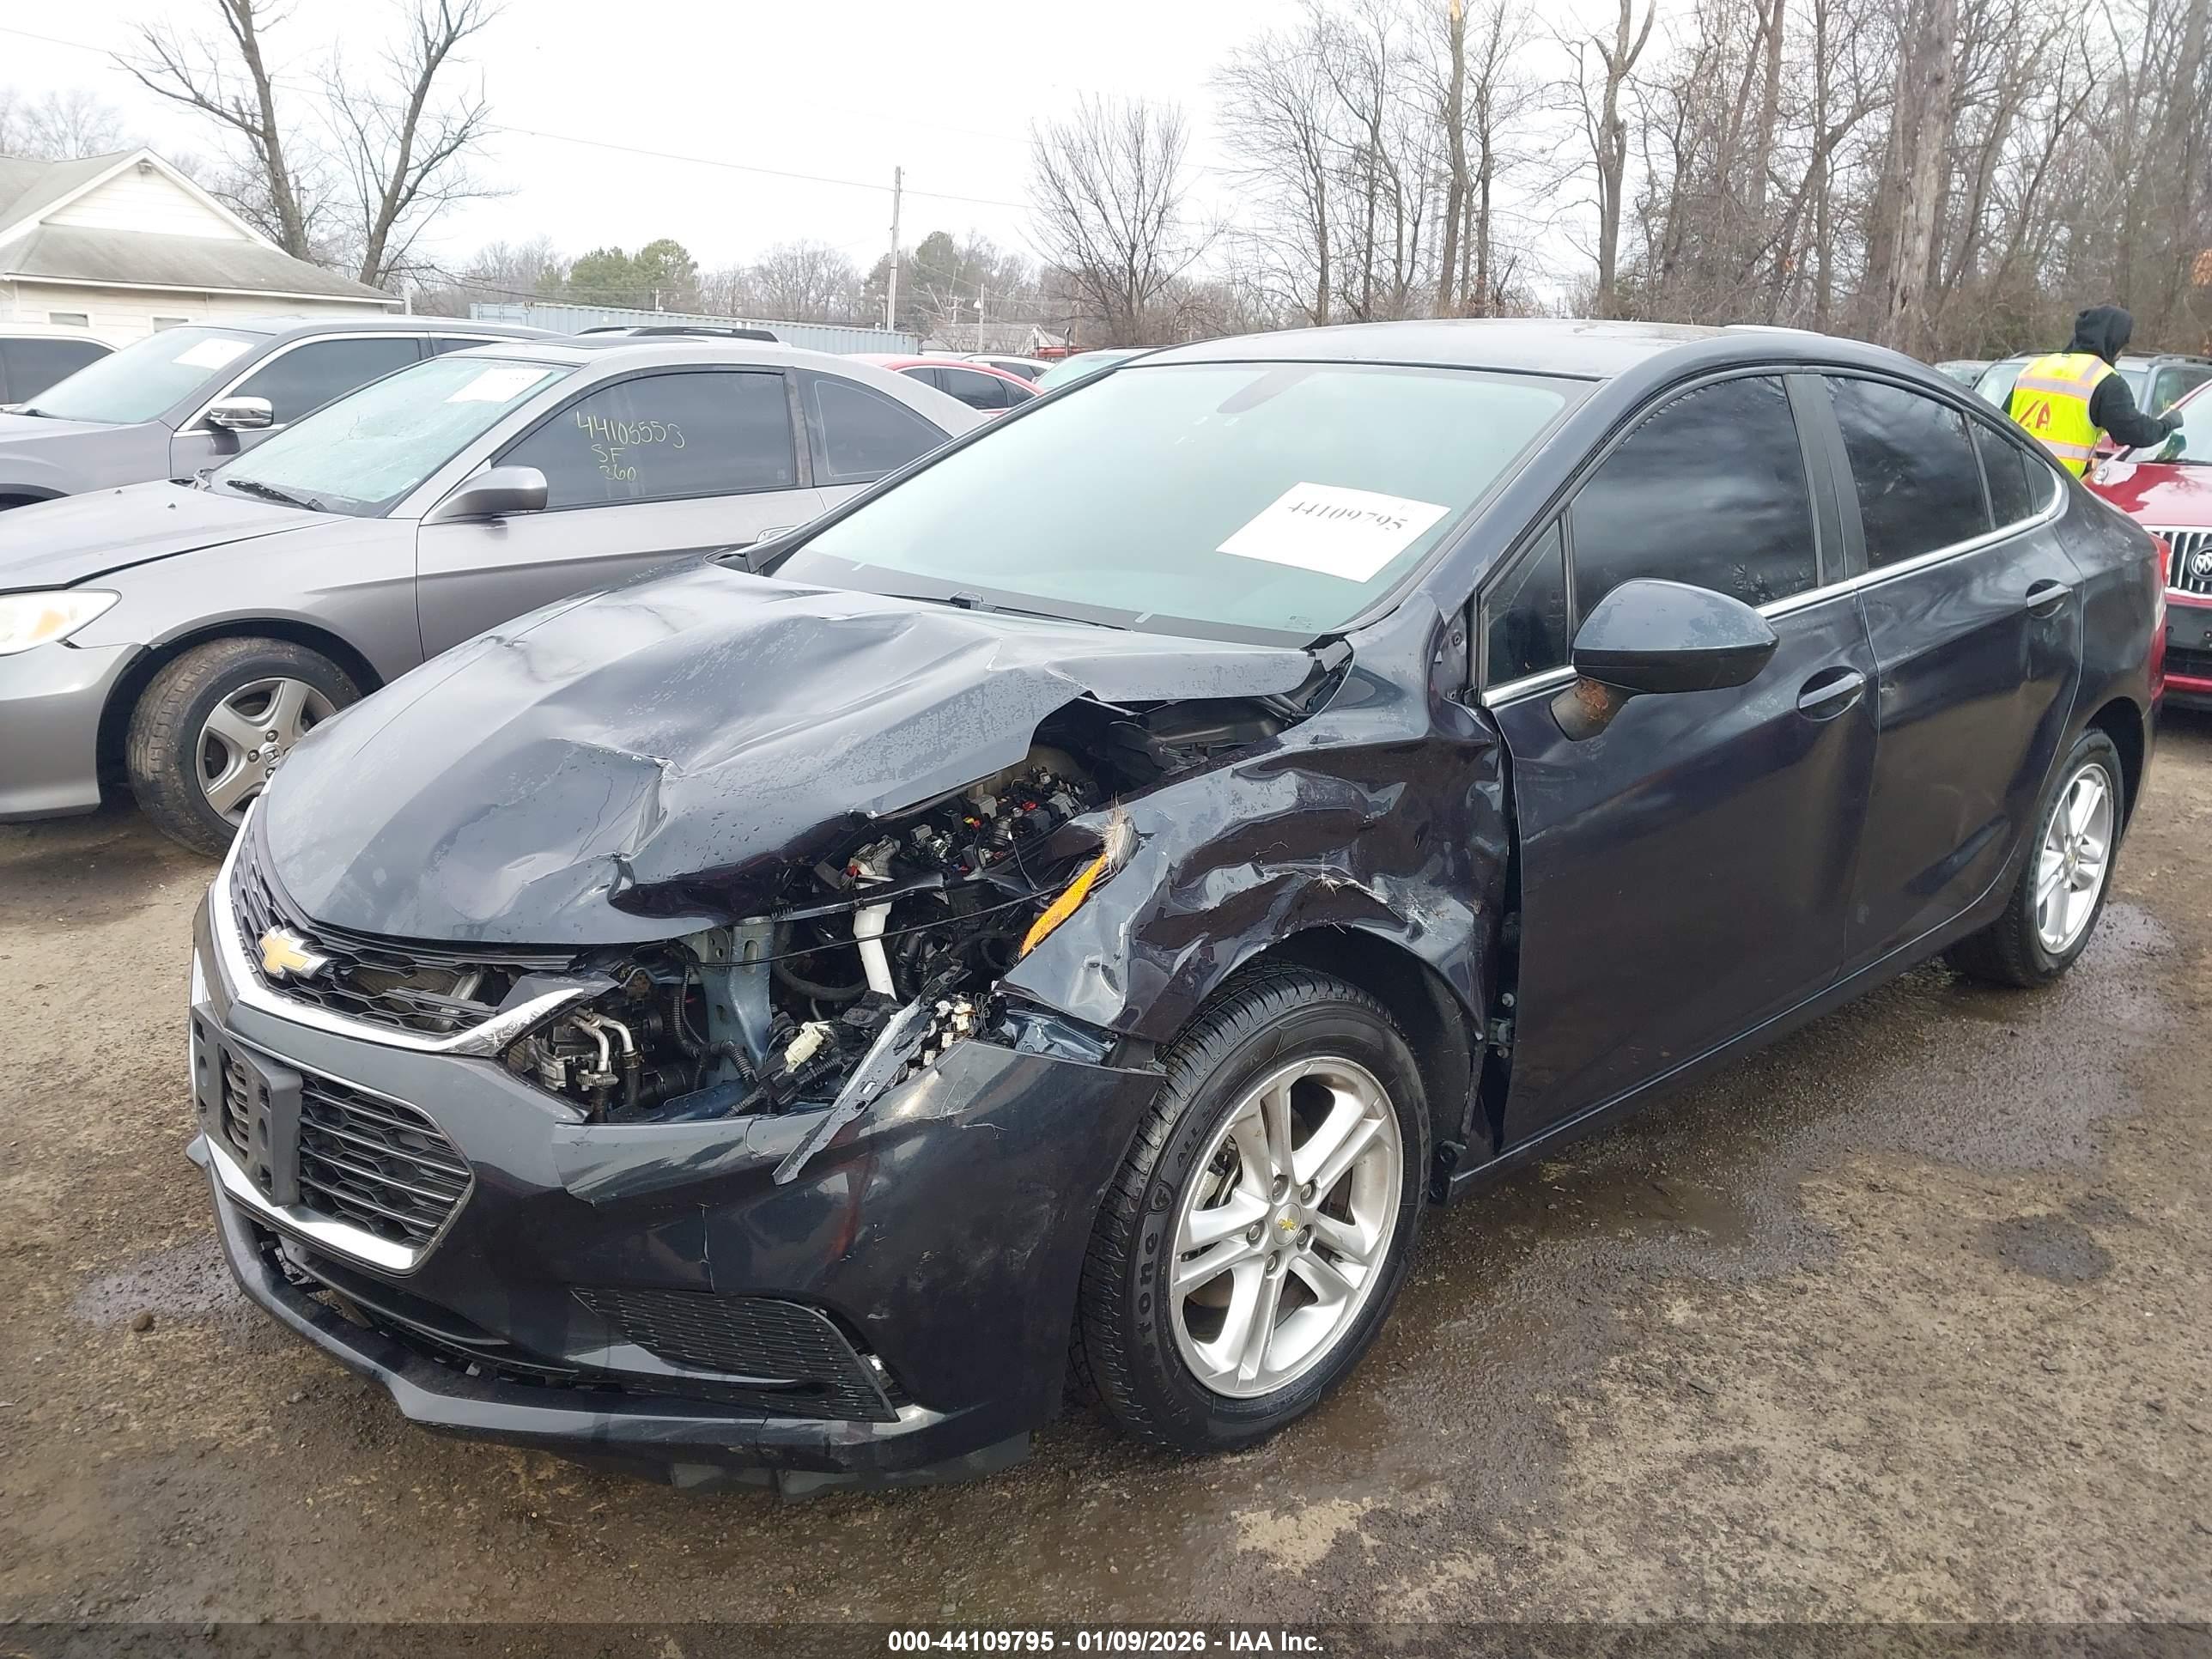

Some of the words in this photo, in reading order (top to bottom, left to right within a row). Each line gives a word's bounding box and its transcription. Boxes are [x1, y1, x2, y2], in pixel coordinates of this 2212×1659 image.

[575, 410, 686, 449] 44105553
[590, 443, 626, 464] SF
[599, 463, 636, 482] 360
[1287, 501, 1408, 531] 44109795
